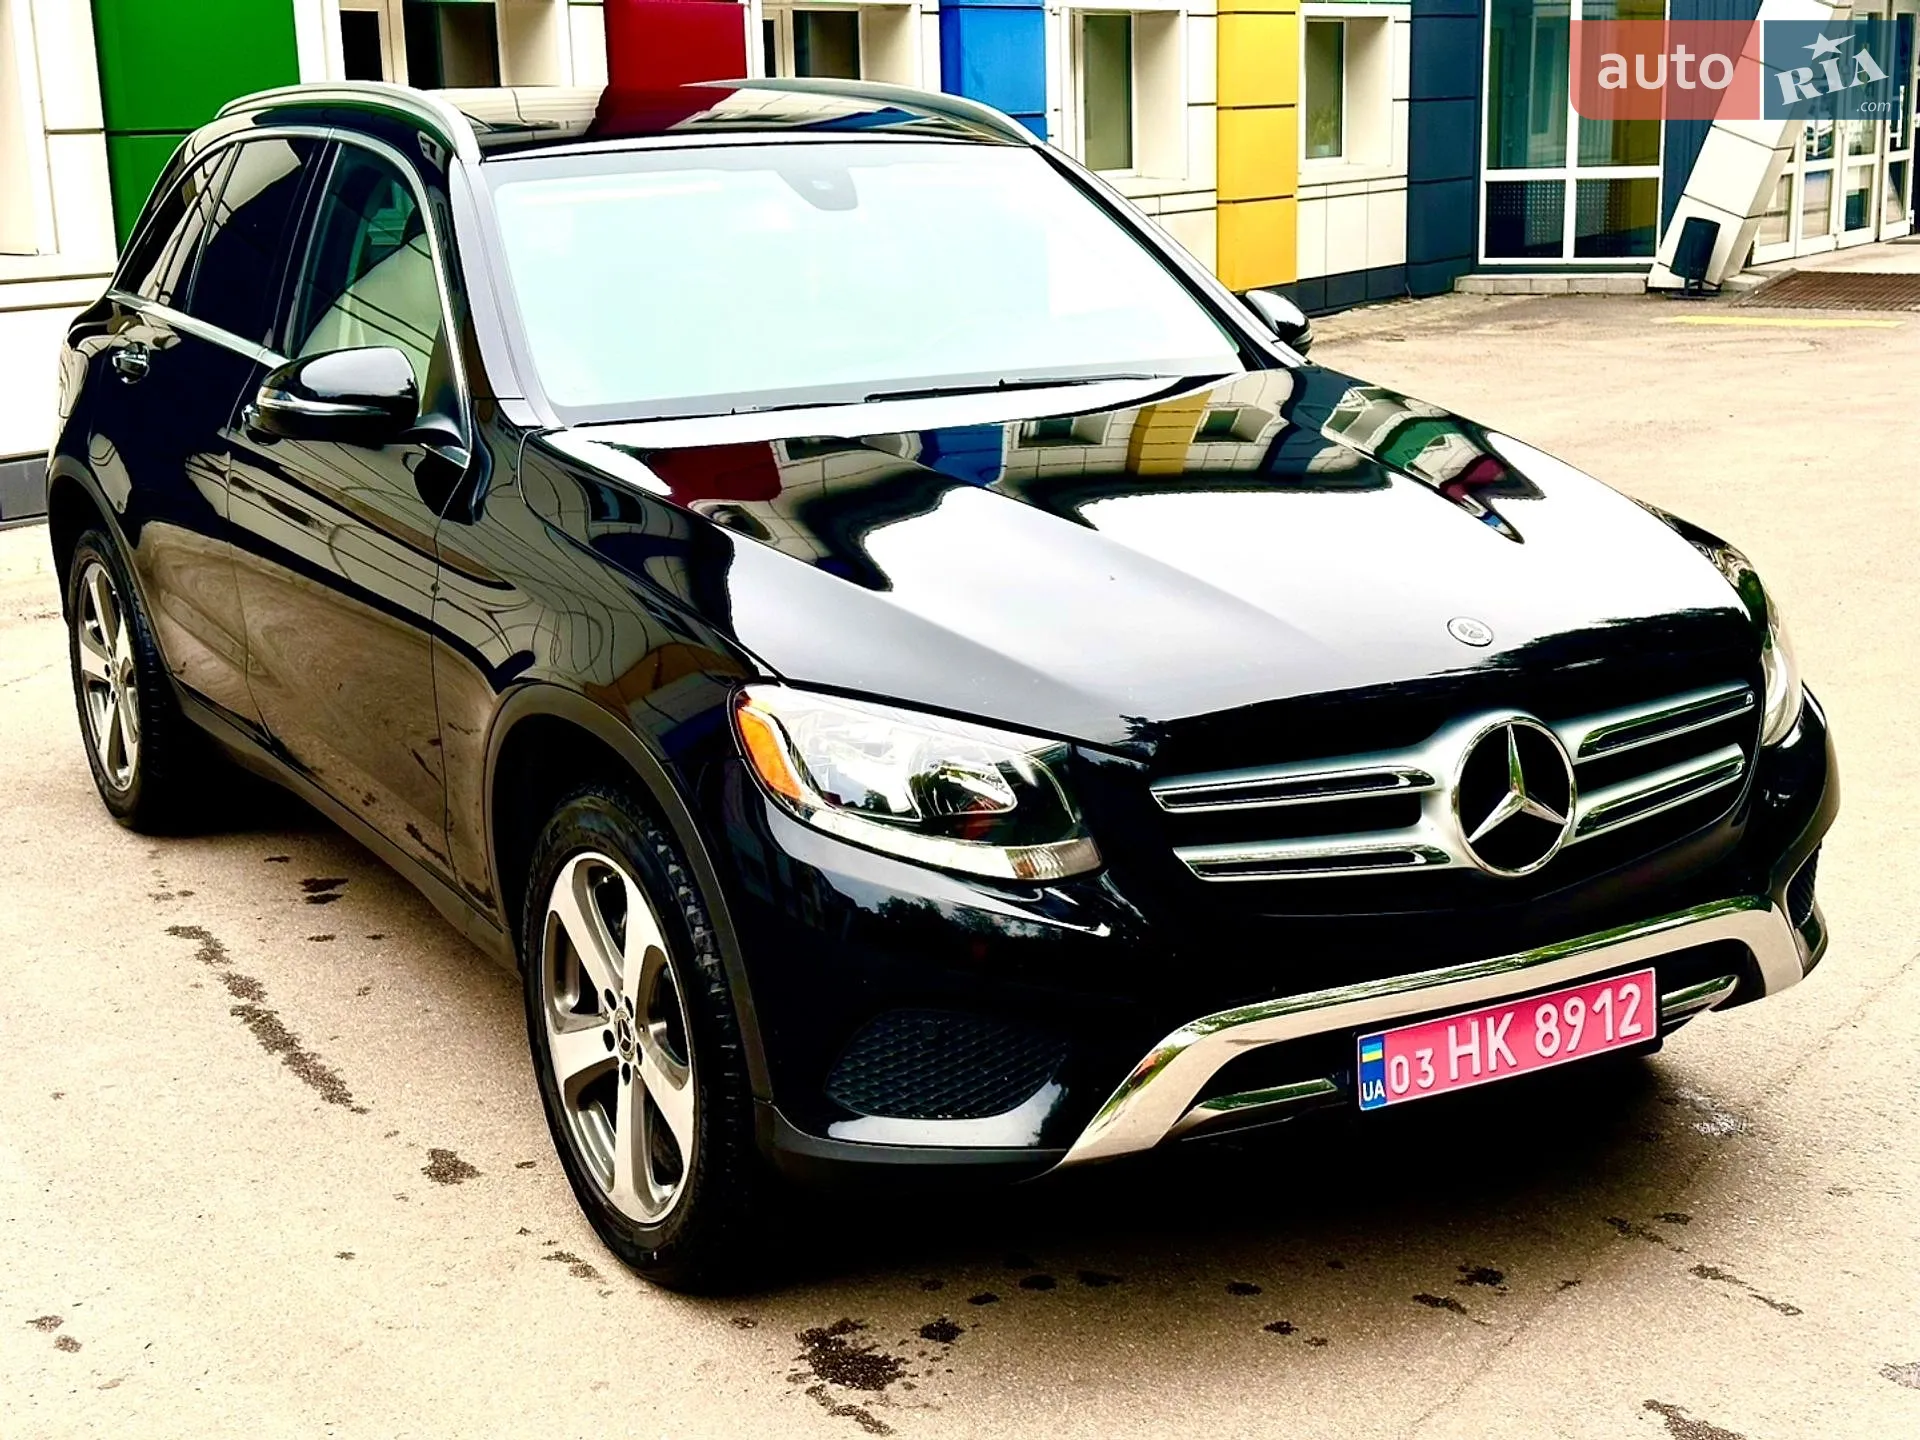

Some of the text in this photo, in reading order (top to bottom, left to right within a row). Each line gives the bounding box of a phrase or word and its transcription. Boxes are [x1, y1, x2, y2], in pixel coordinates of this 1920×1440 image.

[1390, 982, 1642, 1094] 03 HK 8912
[1362, 1081, 1385, 1103] UA
